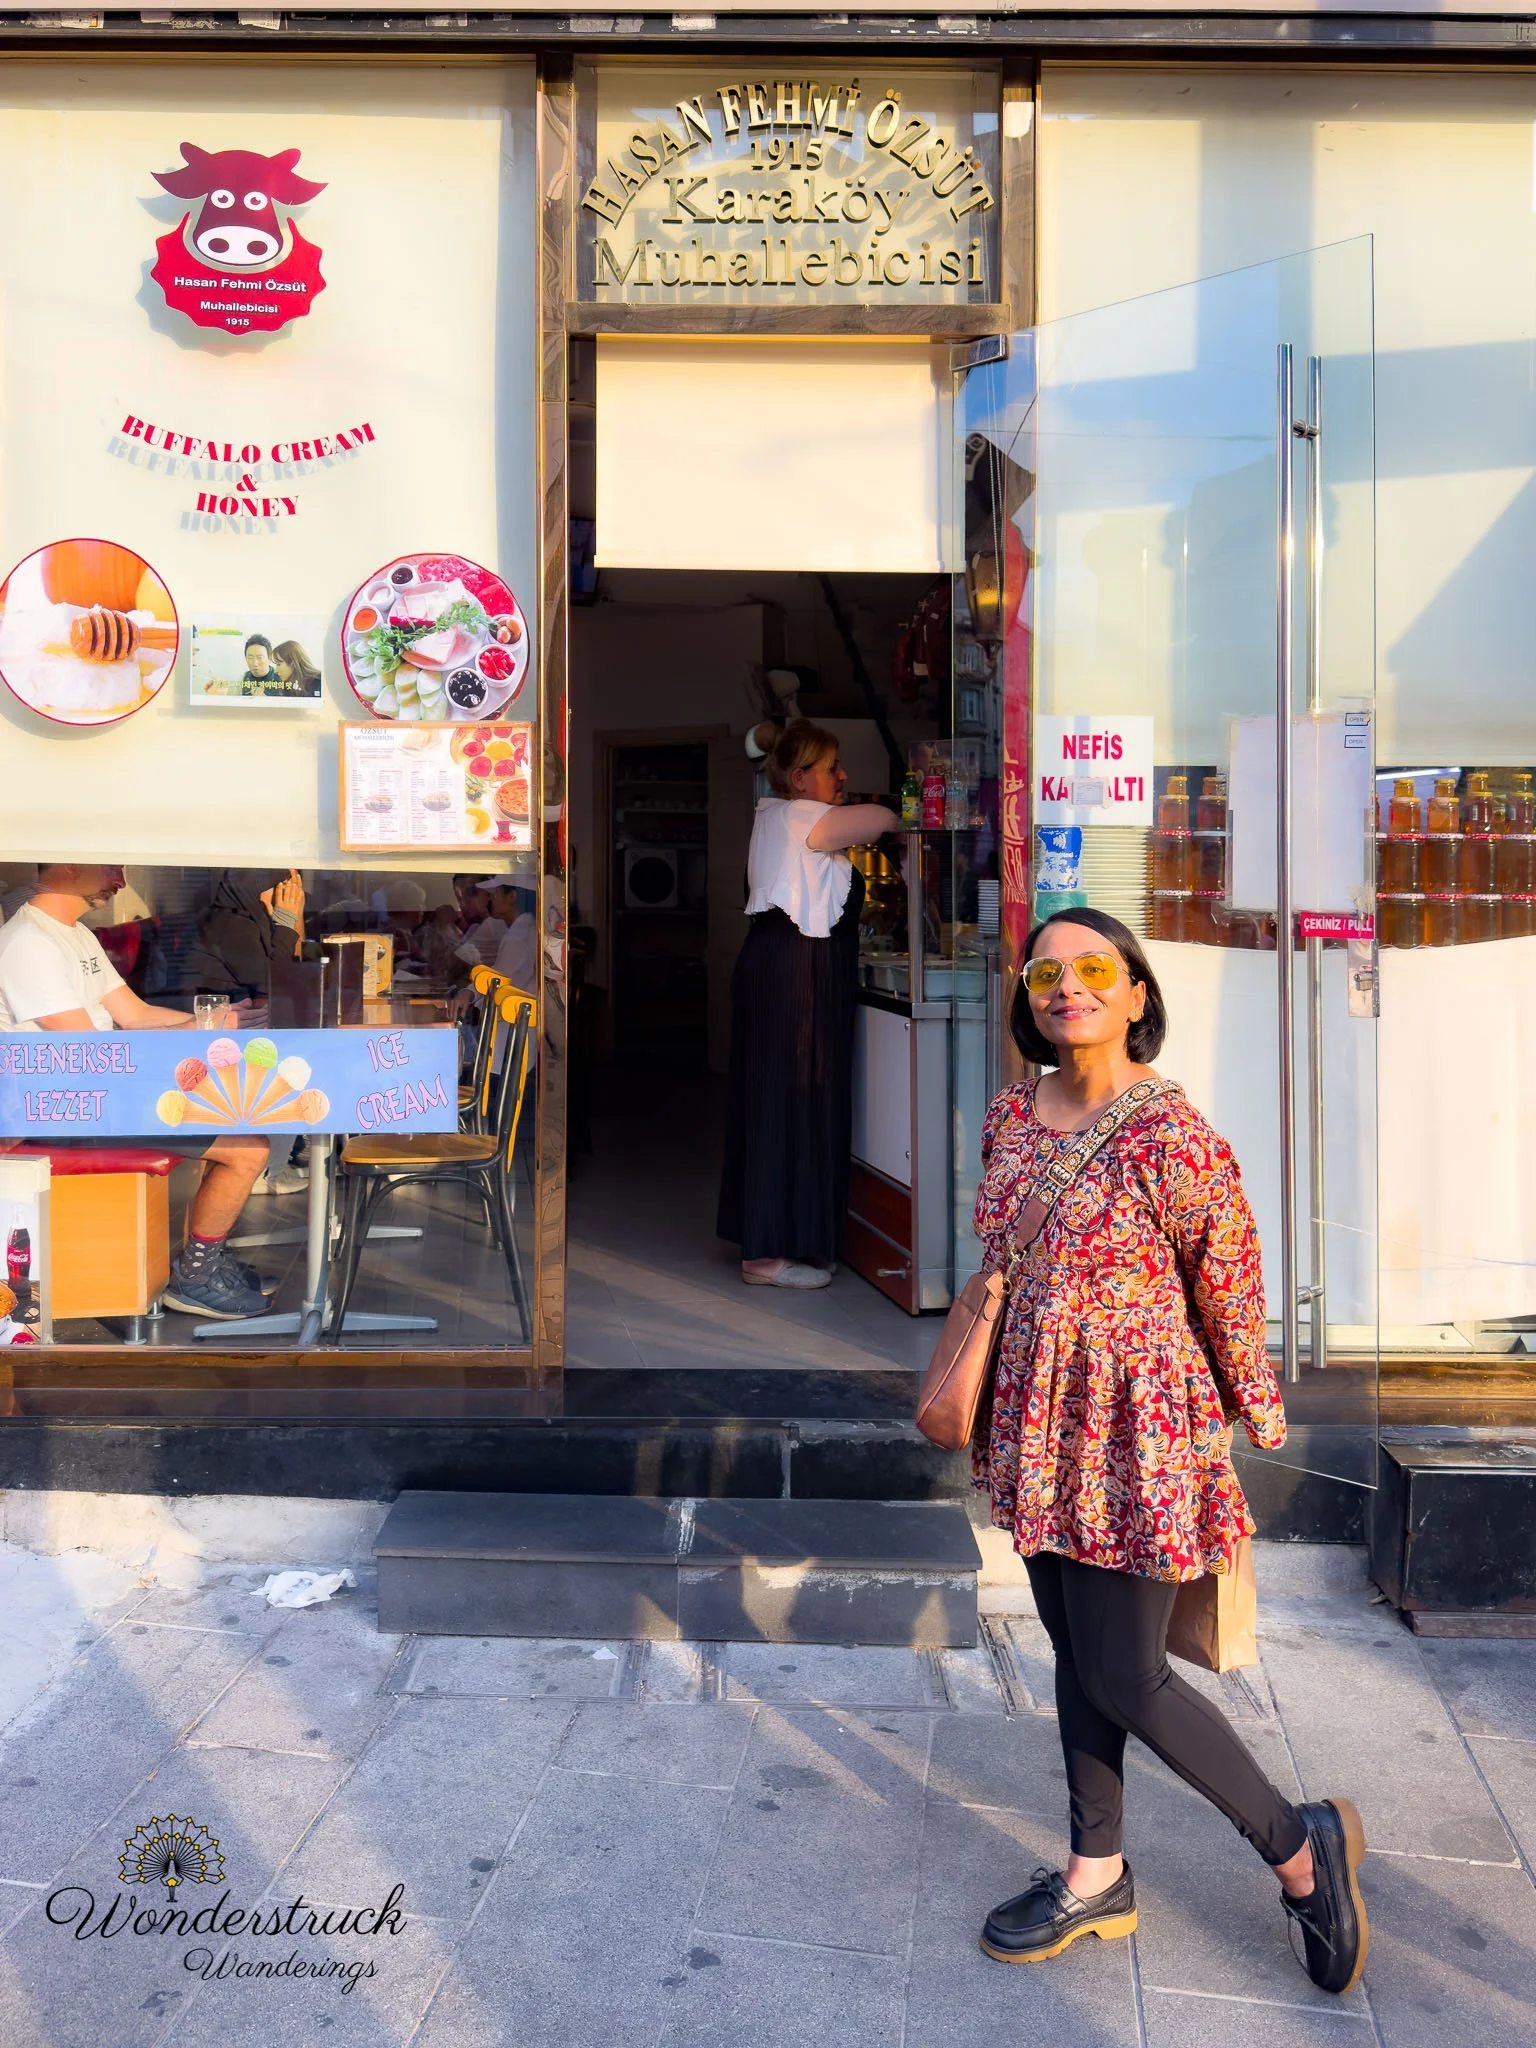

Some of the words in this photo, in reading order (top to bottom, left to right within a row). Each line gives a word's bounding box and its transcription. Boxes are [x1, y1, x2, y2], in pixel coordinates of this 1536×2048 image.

[581, 96, 712, 229] HASAN
[717, 78, 861, 137] FEHMİ
[867, 88, 994, 223] ÖZSÜT
[750, 137, 823, 171] 1915
[662, 175, 911, 234] Karaköy
[592, 237, 985, 287] Muhallebicisi
[174, 276, 217, 288] Hasan
[221, 278, 262, 291] Fehmi
[265, 279, 307, 293] Özsüt
[200, 301, 279, 314] Muhallebicisi
[226, 318, 250, 326] 1915
[120, 414, 261, 465] BUFFALO
[271, 422, 376, 464] CREAM
[236, 473, 259, 492] &
[196, 492, 299, 517] HONEY
[1062, 730, 1123, 760] NEFİS
[1304, 917, 1341, 932] ÇEKİNİZ
[367, 1031, 410, 1072] ICE
[24, 1089, 108, 1121] LEZZET
[356, 1073, 449, 1129] CREAM
